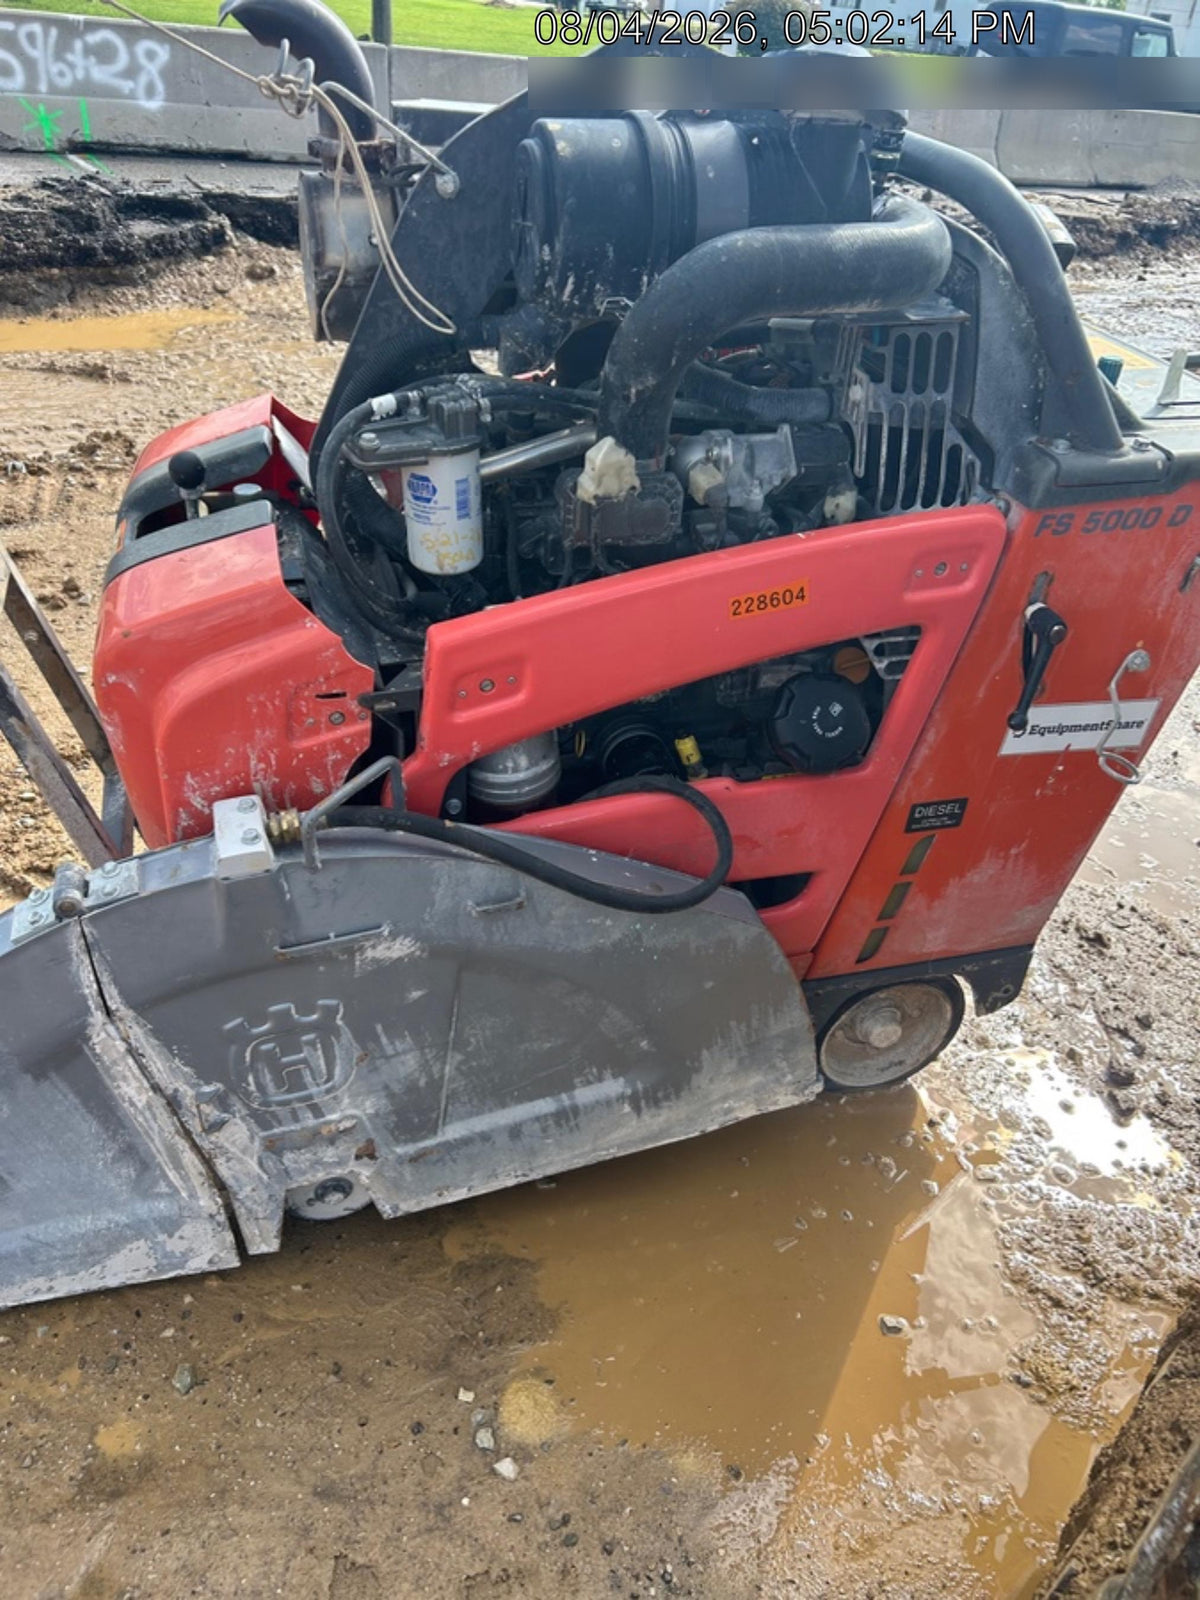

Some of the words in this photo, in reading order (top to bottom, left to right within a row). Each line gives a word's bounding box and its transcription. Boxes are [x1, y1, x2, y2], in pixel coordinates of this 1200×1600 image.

[1034, 513, 1075, 537] FS
[1081, 506, 1163, 534] 5000
[1167, 504, 1194, 527] D
[731, 586, 806, 616] 228604
[914, 802, 962, 819] DIESEL
